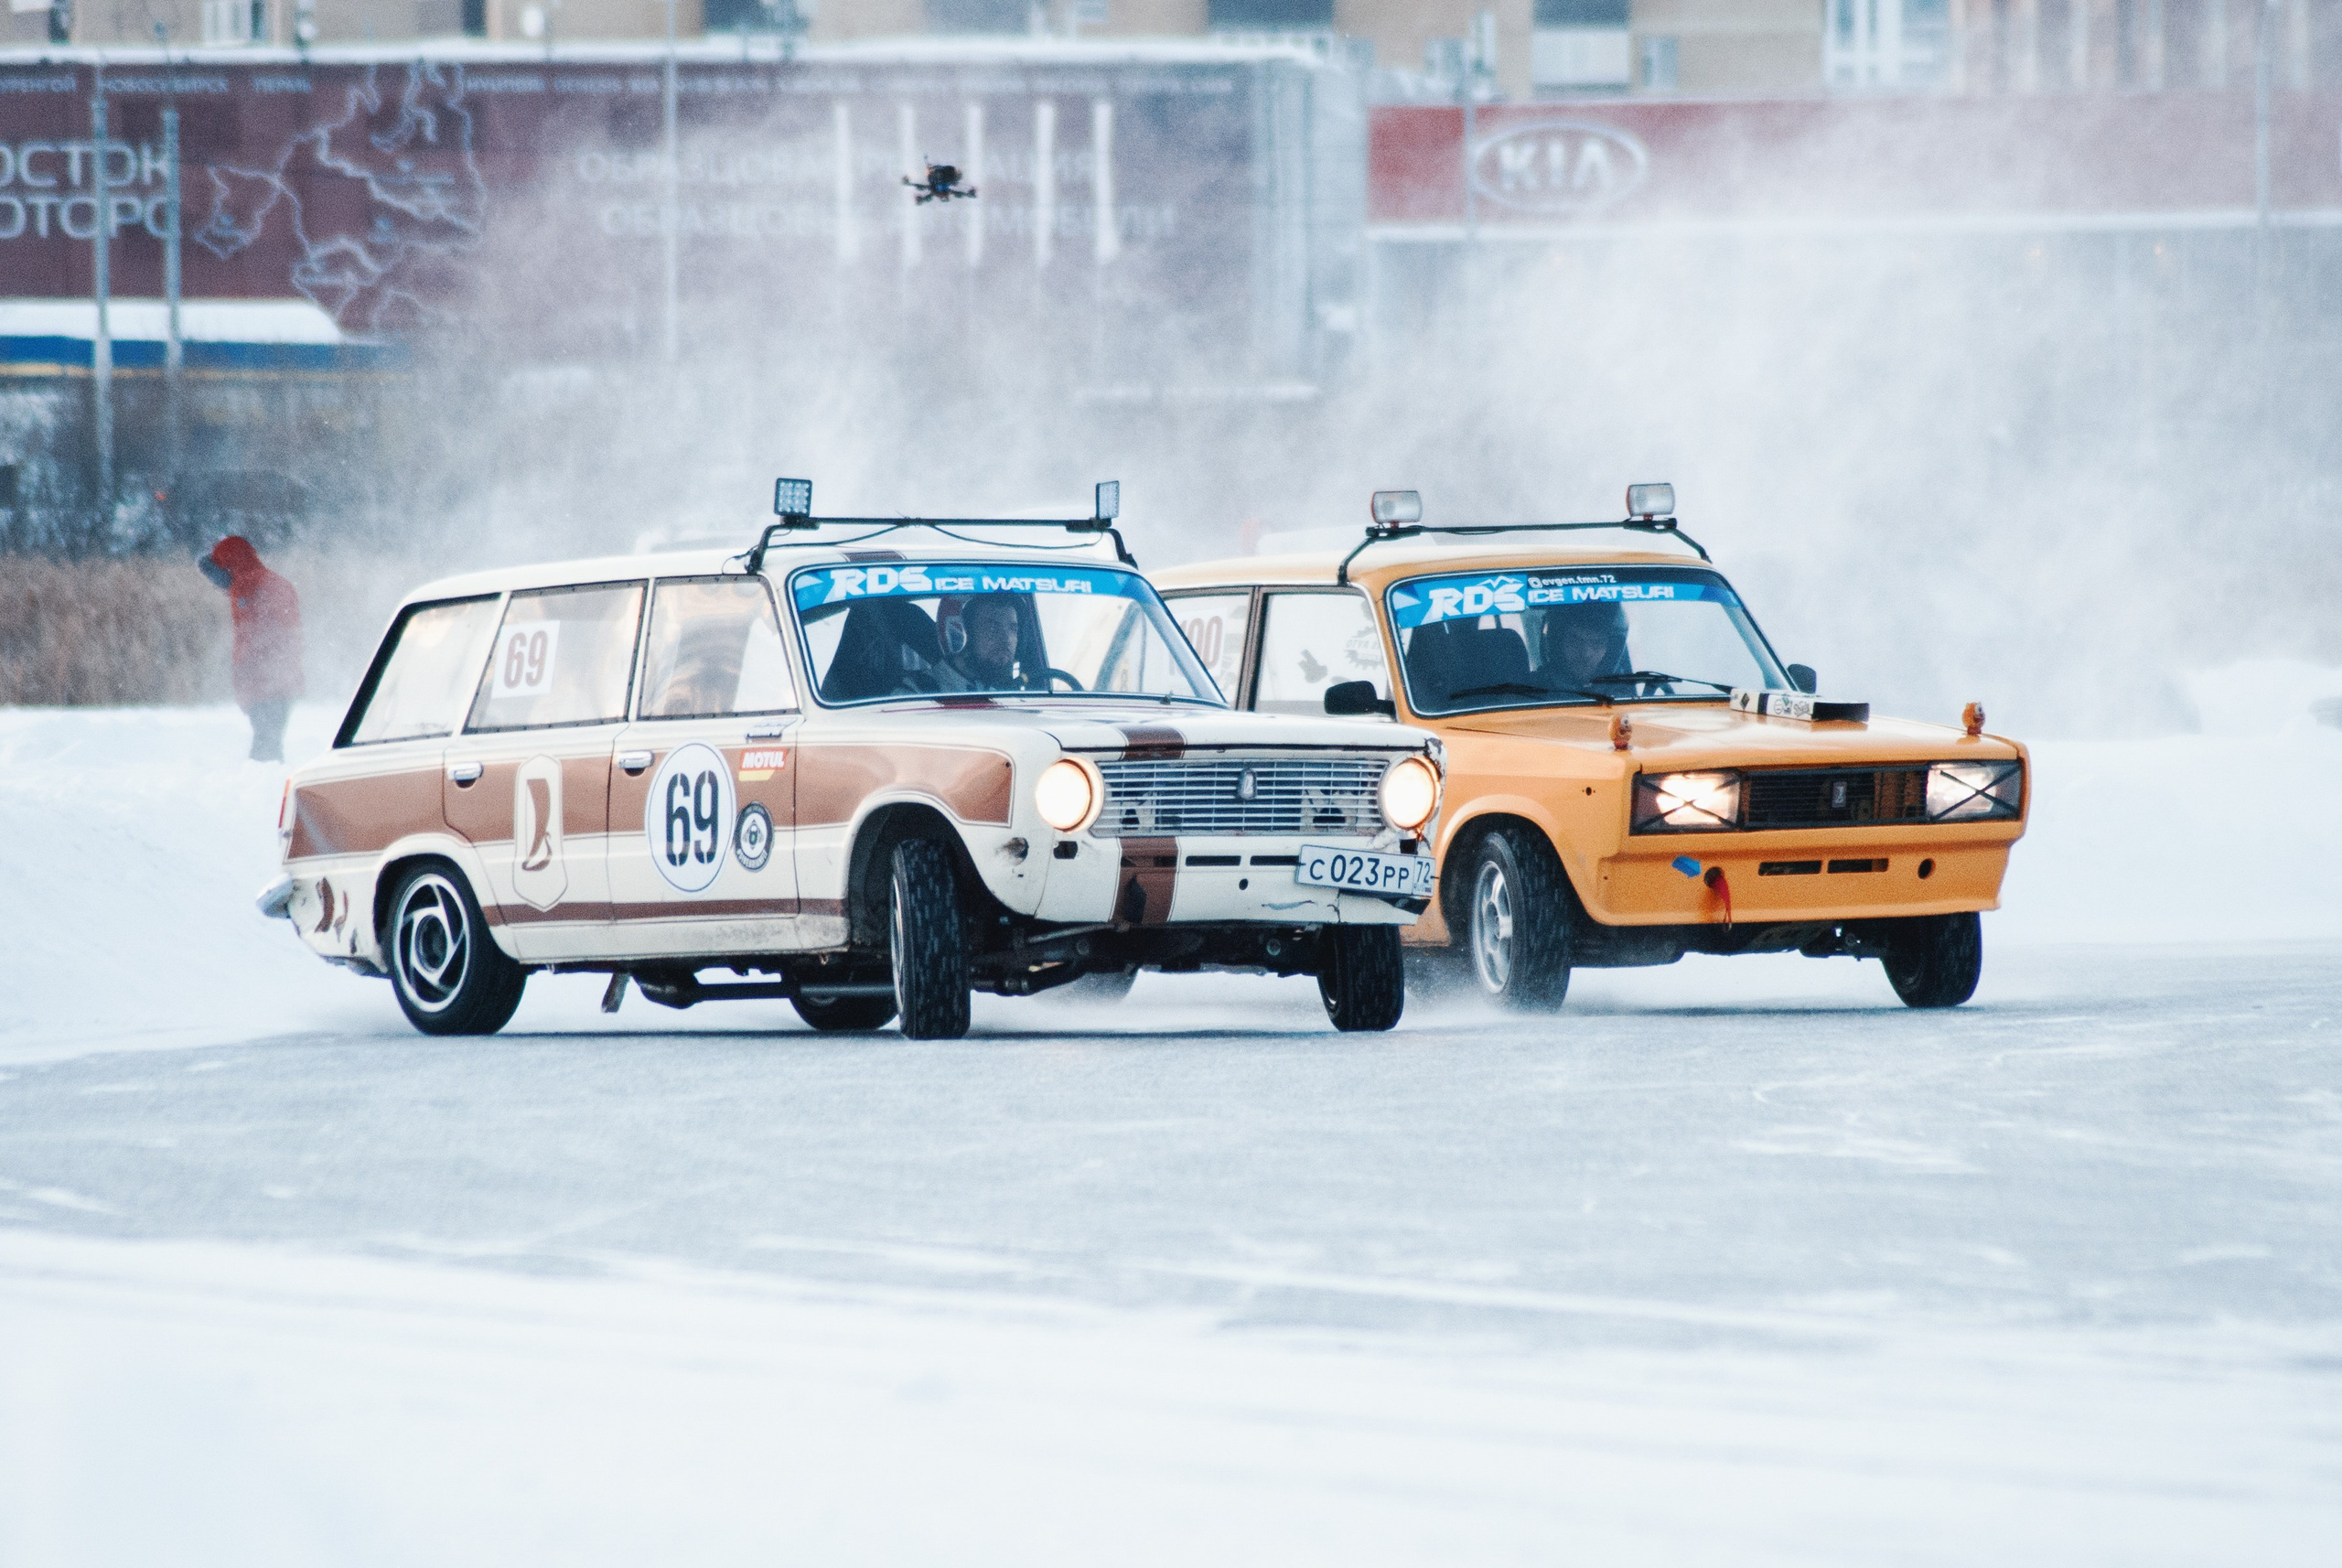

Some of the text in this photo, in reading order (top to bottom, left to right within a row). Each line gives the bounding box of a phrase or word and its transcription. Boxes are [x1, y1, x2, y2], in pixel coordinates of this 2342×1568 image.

[1499, 140, 1616, 191] KIA
[823, 566, 1092, 604] RDS ICE MATSURI
[1420, 582, 1675, 625] RDS ICE MATSURI
[503, 629, 549, 690] 69
[741, 750, 785, 769] MOTUL
[665, 769, 719, 867] 69
